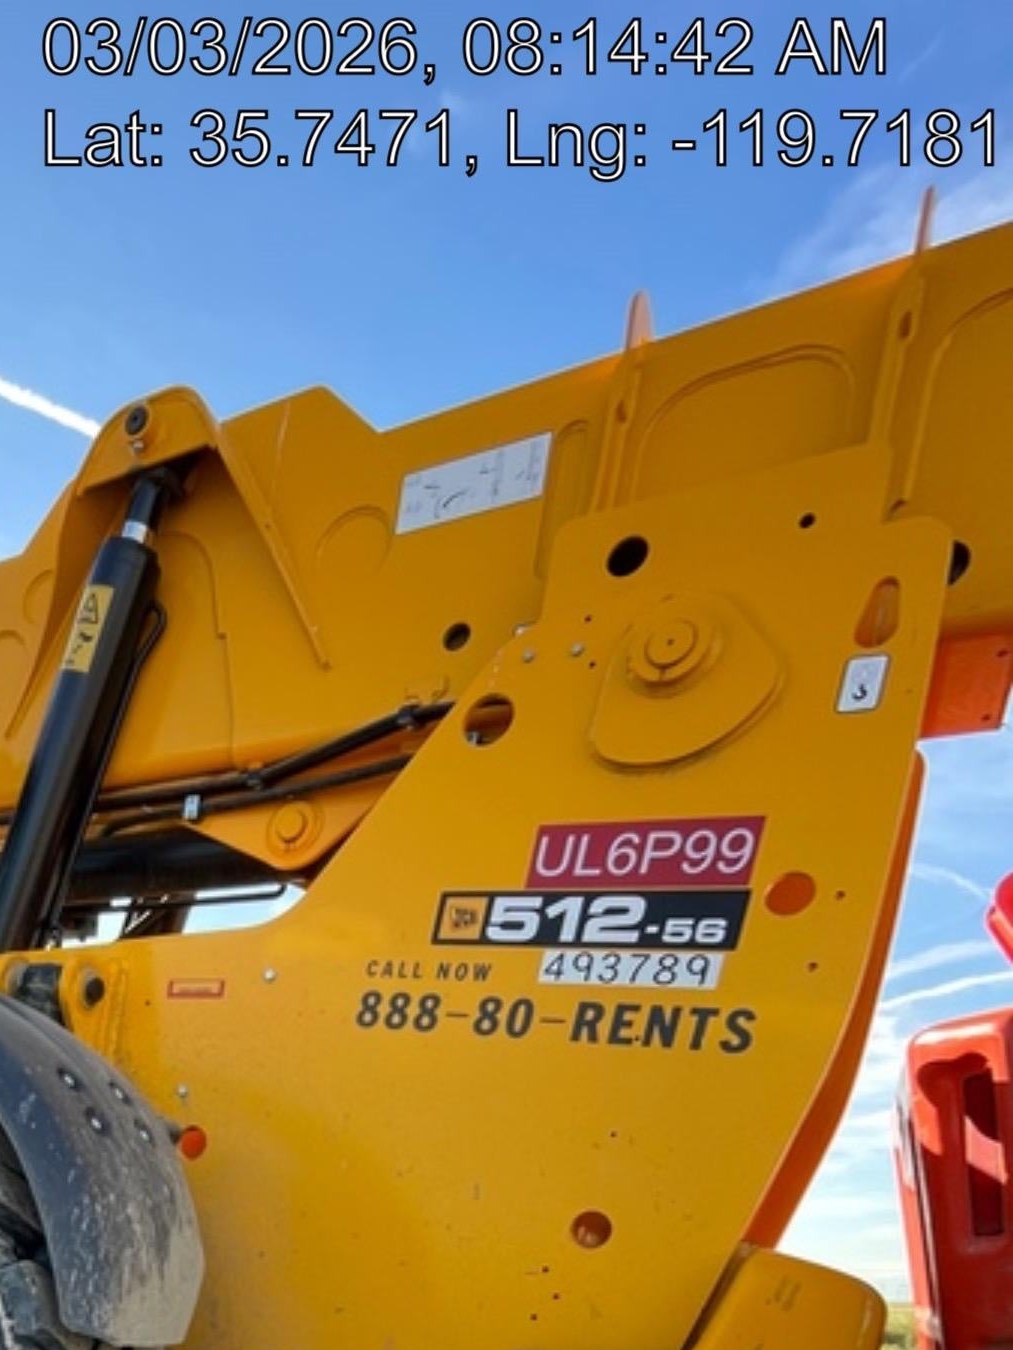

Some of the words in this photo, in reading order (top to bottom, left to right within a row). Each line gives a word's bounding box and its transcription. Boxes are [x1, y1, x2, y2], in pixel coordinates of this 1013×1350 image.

[534, 827, 755, 877] UL6P99
[365, 959, 424, 980] CALL
[436, 962, 492, 982] NOW
[544, 952, 711, 986] 493789
[356, 990, 757, 1054] 888-80-RENTS
